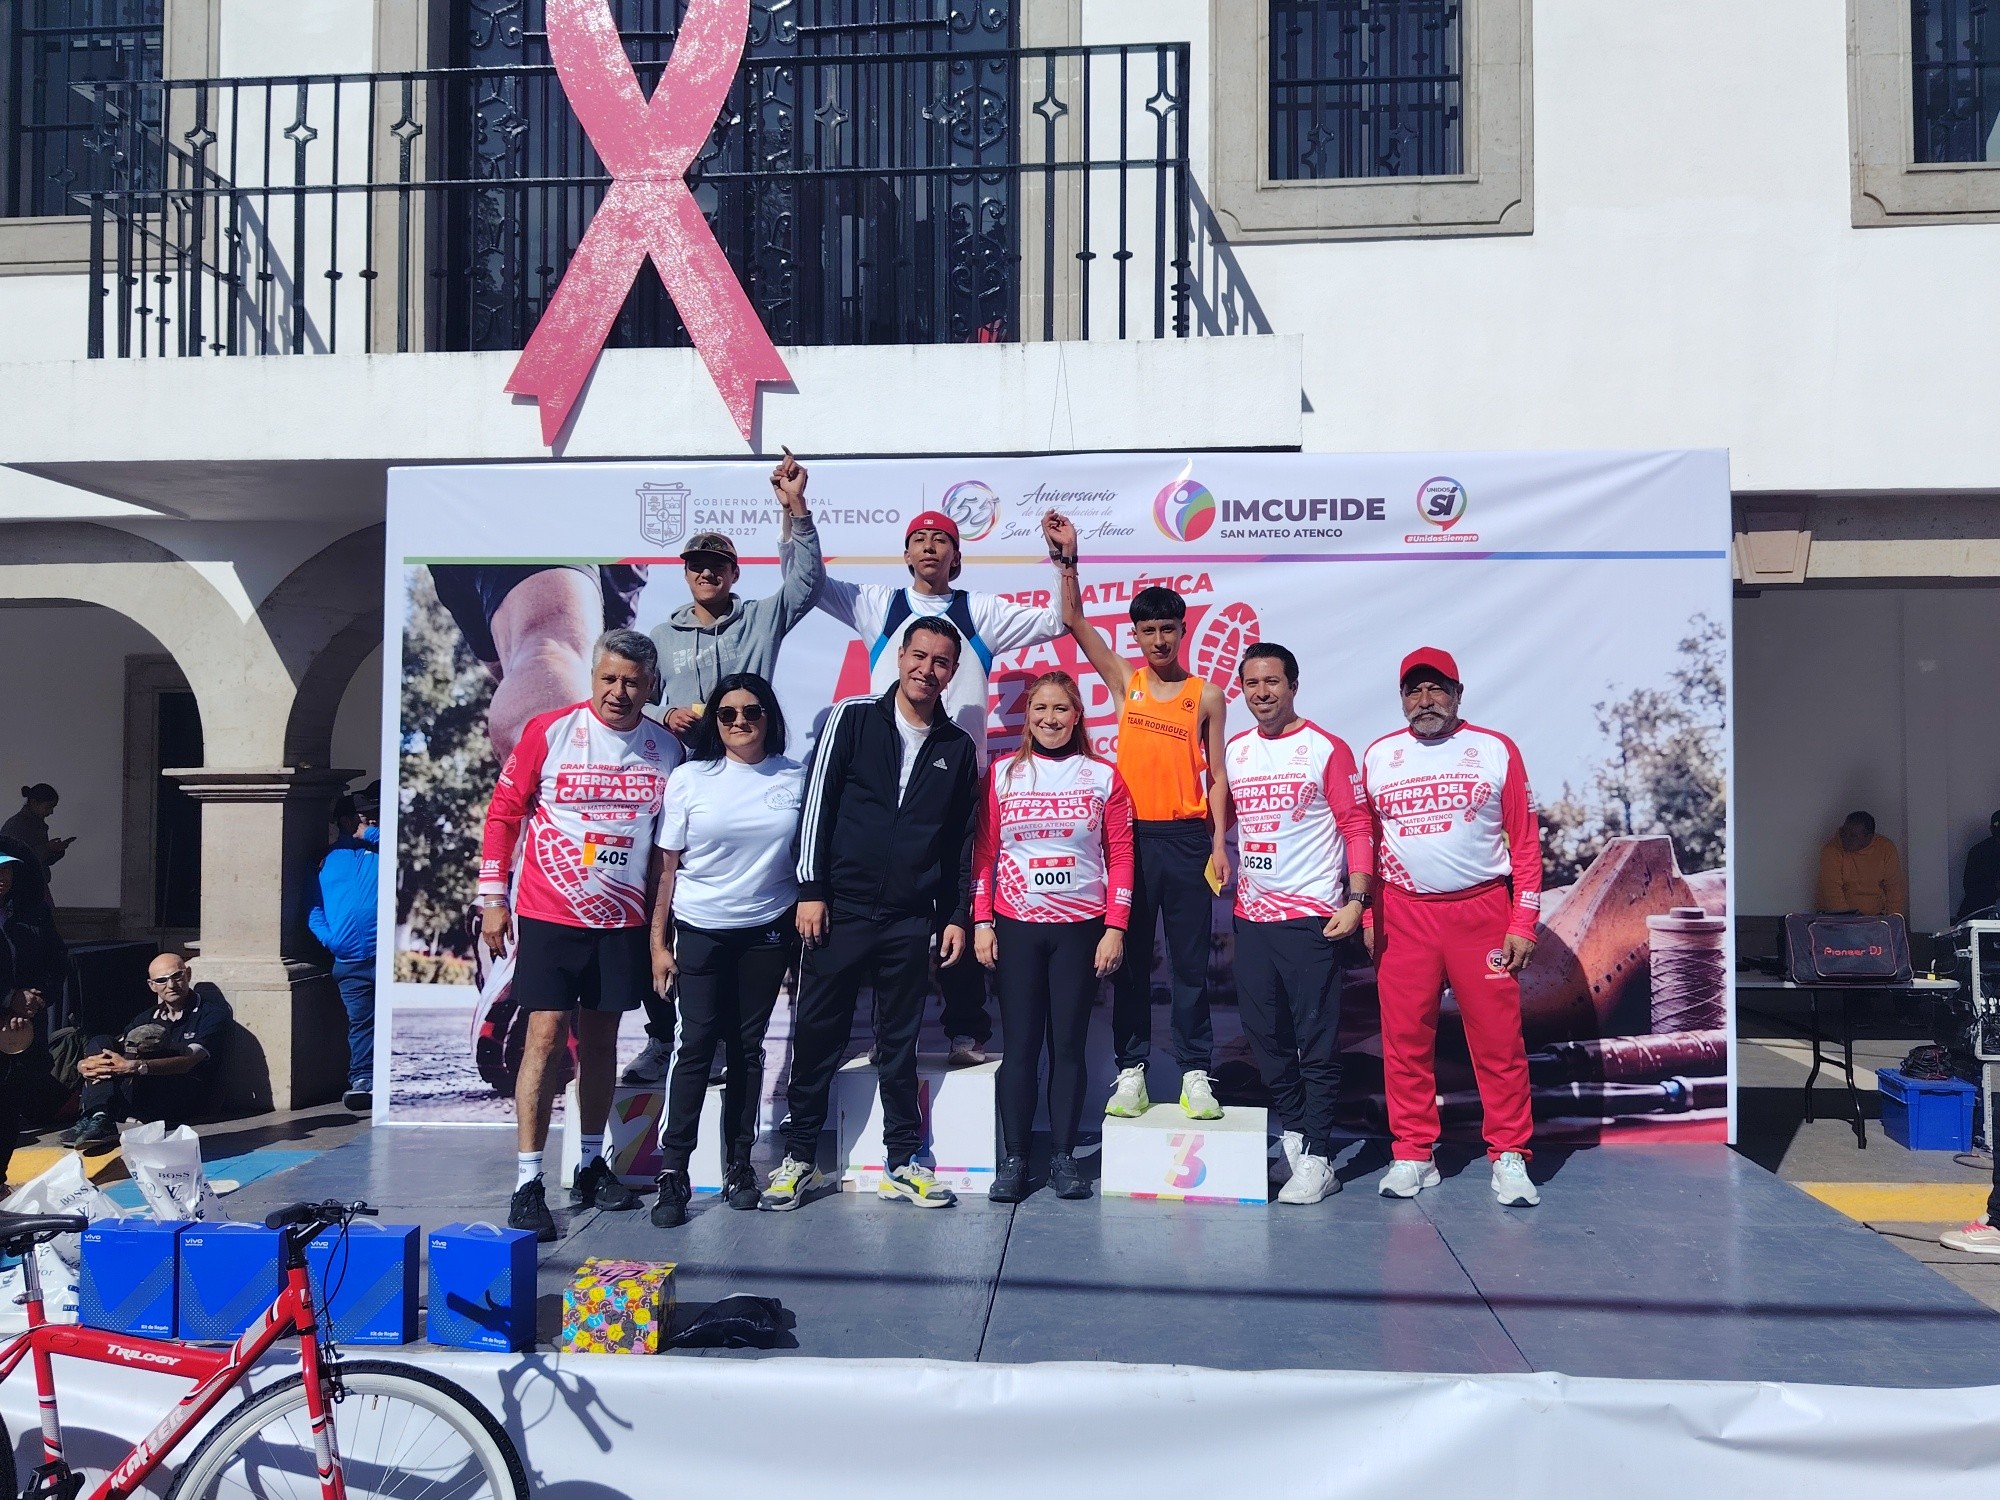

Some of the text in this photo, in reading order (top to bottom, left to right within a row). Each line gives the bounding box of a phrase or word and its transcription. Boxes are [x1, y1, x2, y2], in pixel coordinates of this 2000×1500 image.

[1016, 482, 1118, 506] Aniversario
[1427, 487, 1458, 516] SÍ
[693, 498, 758, 506] GOBIERNO
[694, 509, 734, 524] SAN
[817, 508, 901, 524] ATENCO
[1022, 506, 1034, 516] de
[1101, 506, 1113, 516] de
[1221, 498, 1386, 522] IMCUFIDE
[1001, 521, 1032, 540] San
[1084, 520, 1137, 540] Atenco
[1221, 528, 1343, 539] SAN MATEO ATENCO
[1407, 534, 1478, 542] #UnidosSiempre
[1127, 716, 1189, 737] TEAM RODRIGUEZ
[587, 763, 625, 772] CARRERA
[566, 775, 653, 787] TIERRA DEL
[1242, 775, 1272, 784] CARRERA
[1272, 771, 1307, 780] ATLÉTICA
[1380, 771, 1480, 792] GRAN CARRERA ATLÉTICA
[560, 786, 654, 801] CALZADO
[1232, 784, 1295, 799] TIERRA DEL
[1383, 783, 1468, 804] TIERRA DEL
[1005, 797, 1087, 811] TIERRA DEL
[1235, 795, 1295, 813] ALZADO
[1403, 817, 1425, 825] MATEO
[1427, 813, 1453, 822] ATENCO
[1018, 823, 1043, 831] MATEO
[595, 849, 628, 866] 405
[1244, 855, 1272, 870] 0628
[1034, 871, 1071, 885] 0001
[1824, 945, 1882, 956] Pioneer DJ
[1164, 1133, 1207, 1189] 3
[158, 1171, 190, 1179] BOSS
[60, 1185, 89, 1206] BOSS
[431, 1239, 447, 1247] vivo
[107, 1343, 182, 1366] TRILOGY
[110, 1406, 185, 1489] KAISER
